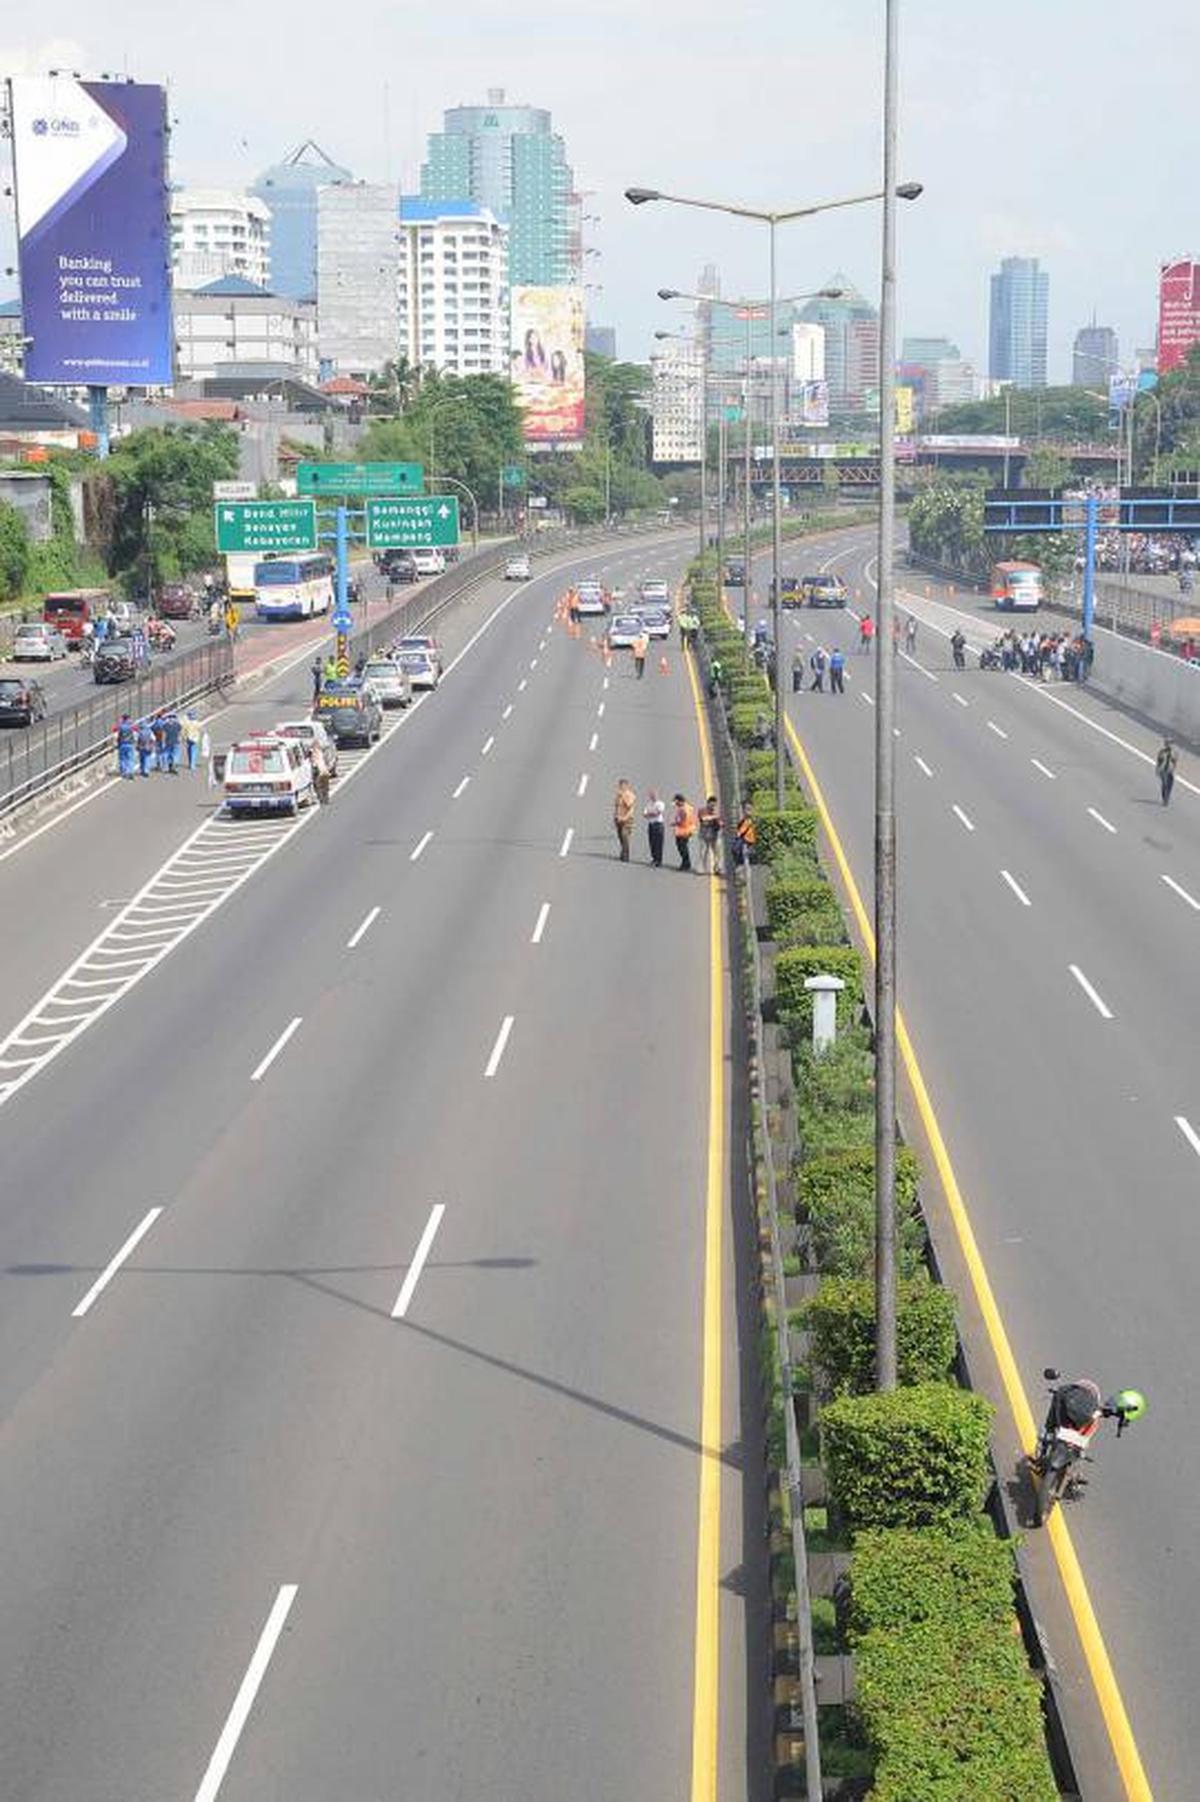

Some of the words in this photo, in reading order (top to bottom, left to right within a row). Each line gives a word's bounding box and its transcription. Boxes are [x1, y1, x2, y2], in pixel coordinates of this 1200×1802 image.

[59, 256, 112, 273] Banking
[60, 277, 83, 289] you
[86, 277, 108, 288] can
[110, 275, 142, 288] trust
[59, 290, 117, 304] delivered
[61, 306, 90, 320] with
[92, 309, 101, 320] a
[103, 307, 137, 320] smile
[373, 504, 434, 517] Semanggi
